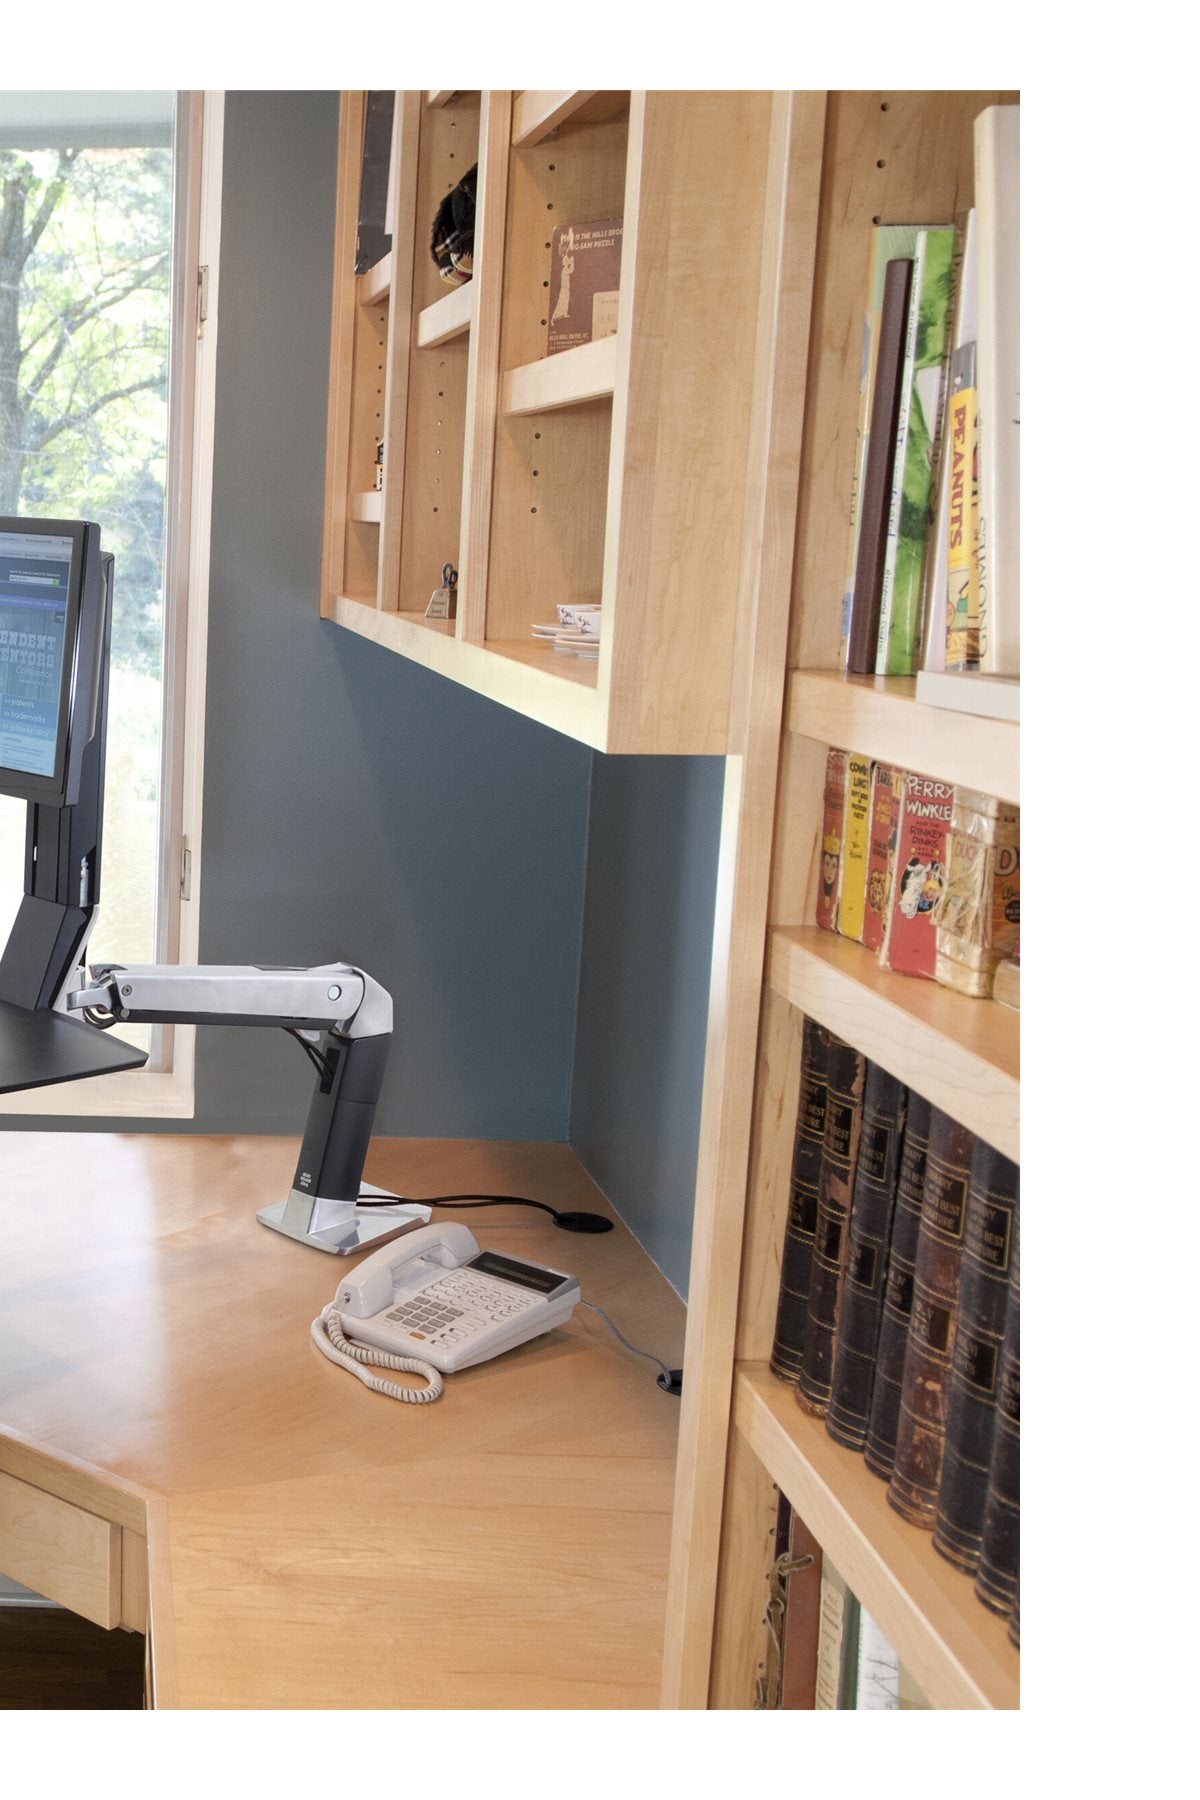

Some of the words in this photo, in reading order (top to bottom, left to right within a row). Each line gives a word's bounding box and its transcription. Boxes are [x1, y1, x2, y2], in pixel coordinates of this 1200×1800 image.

[949, 404, 967, 551] PEANUTS
[11, 699, 35, 709] patents
[10, 710, 46, 724] trademarks
[906, 775, 956, 800] PERRY
[906, 799, 952, 821] WINKLE
[912, 835, 939, 849] DINKS
